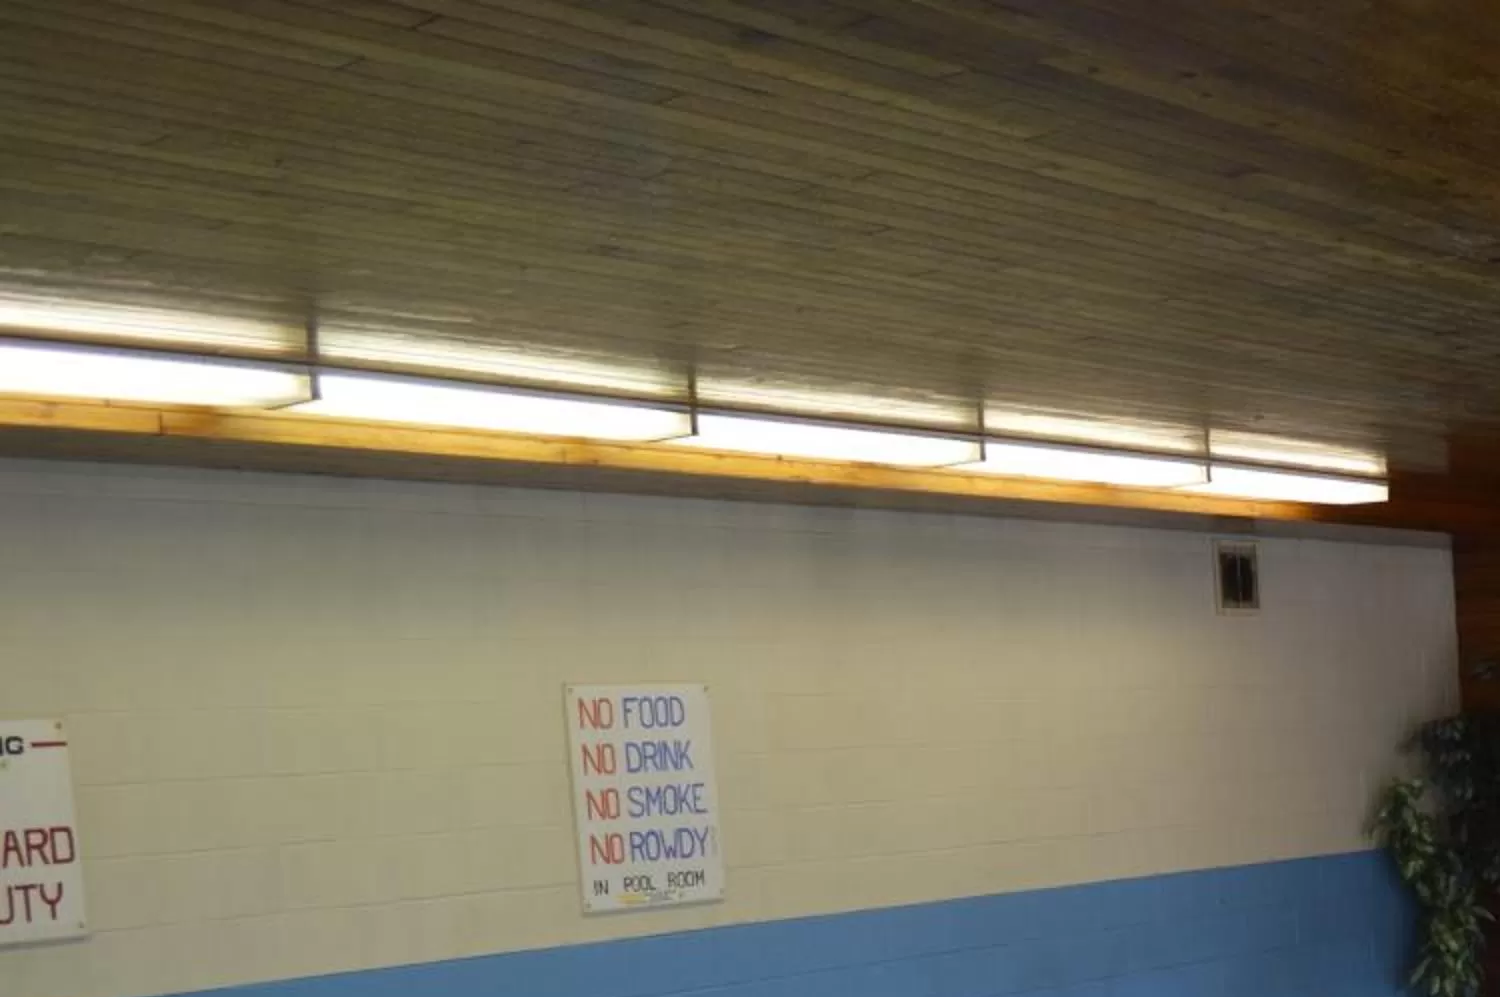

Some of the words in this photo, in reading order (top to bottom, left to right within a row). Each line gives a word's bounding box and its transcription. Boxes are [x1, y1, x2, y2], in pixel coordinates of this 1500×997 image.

[577, 697, 614, 730] NO
[621, 695, 686, 729] FOOD
[581, 742, 617, 776] NO
[624, 739, 695, 774] DRINK
[585, 787, 621, 821] NO
[626, 782, 709, 819] SMOKE
[2, 825, 76, 869] ARD
[589, 831, 626, 865] NO
[628, 824, 710, 864] ROWDY
[593, 879, 609, 897] IN
[623, 874, 657, 893] POOL
[667, 869, 705, 889] ROOM
